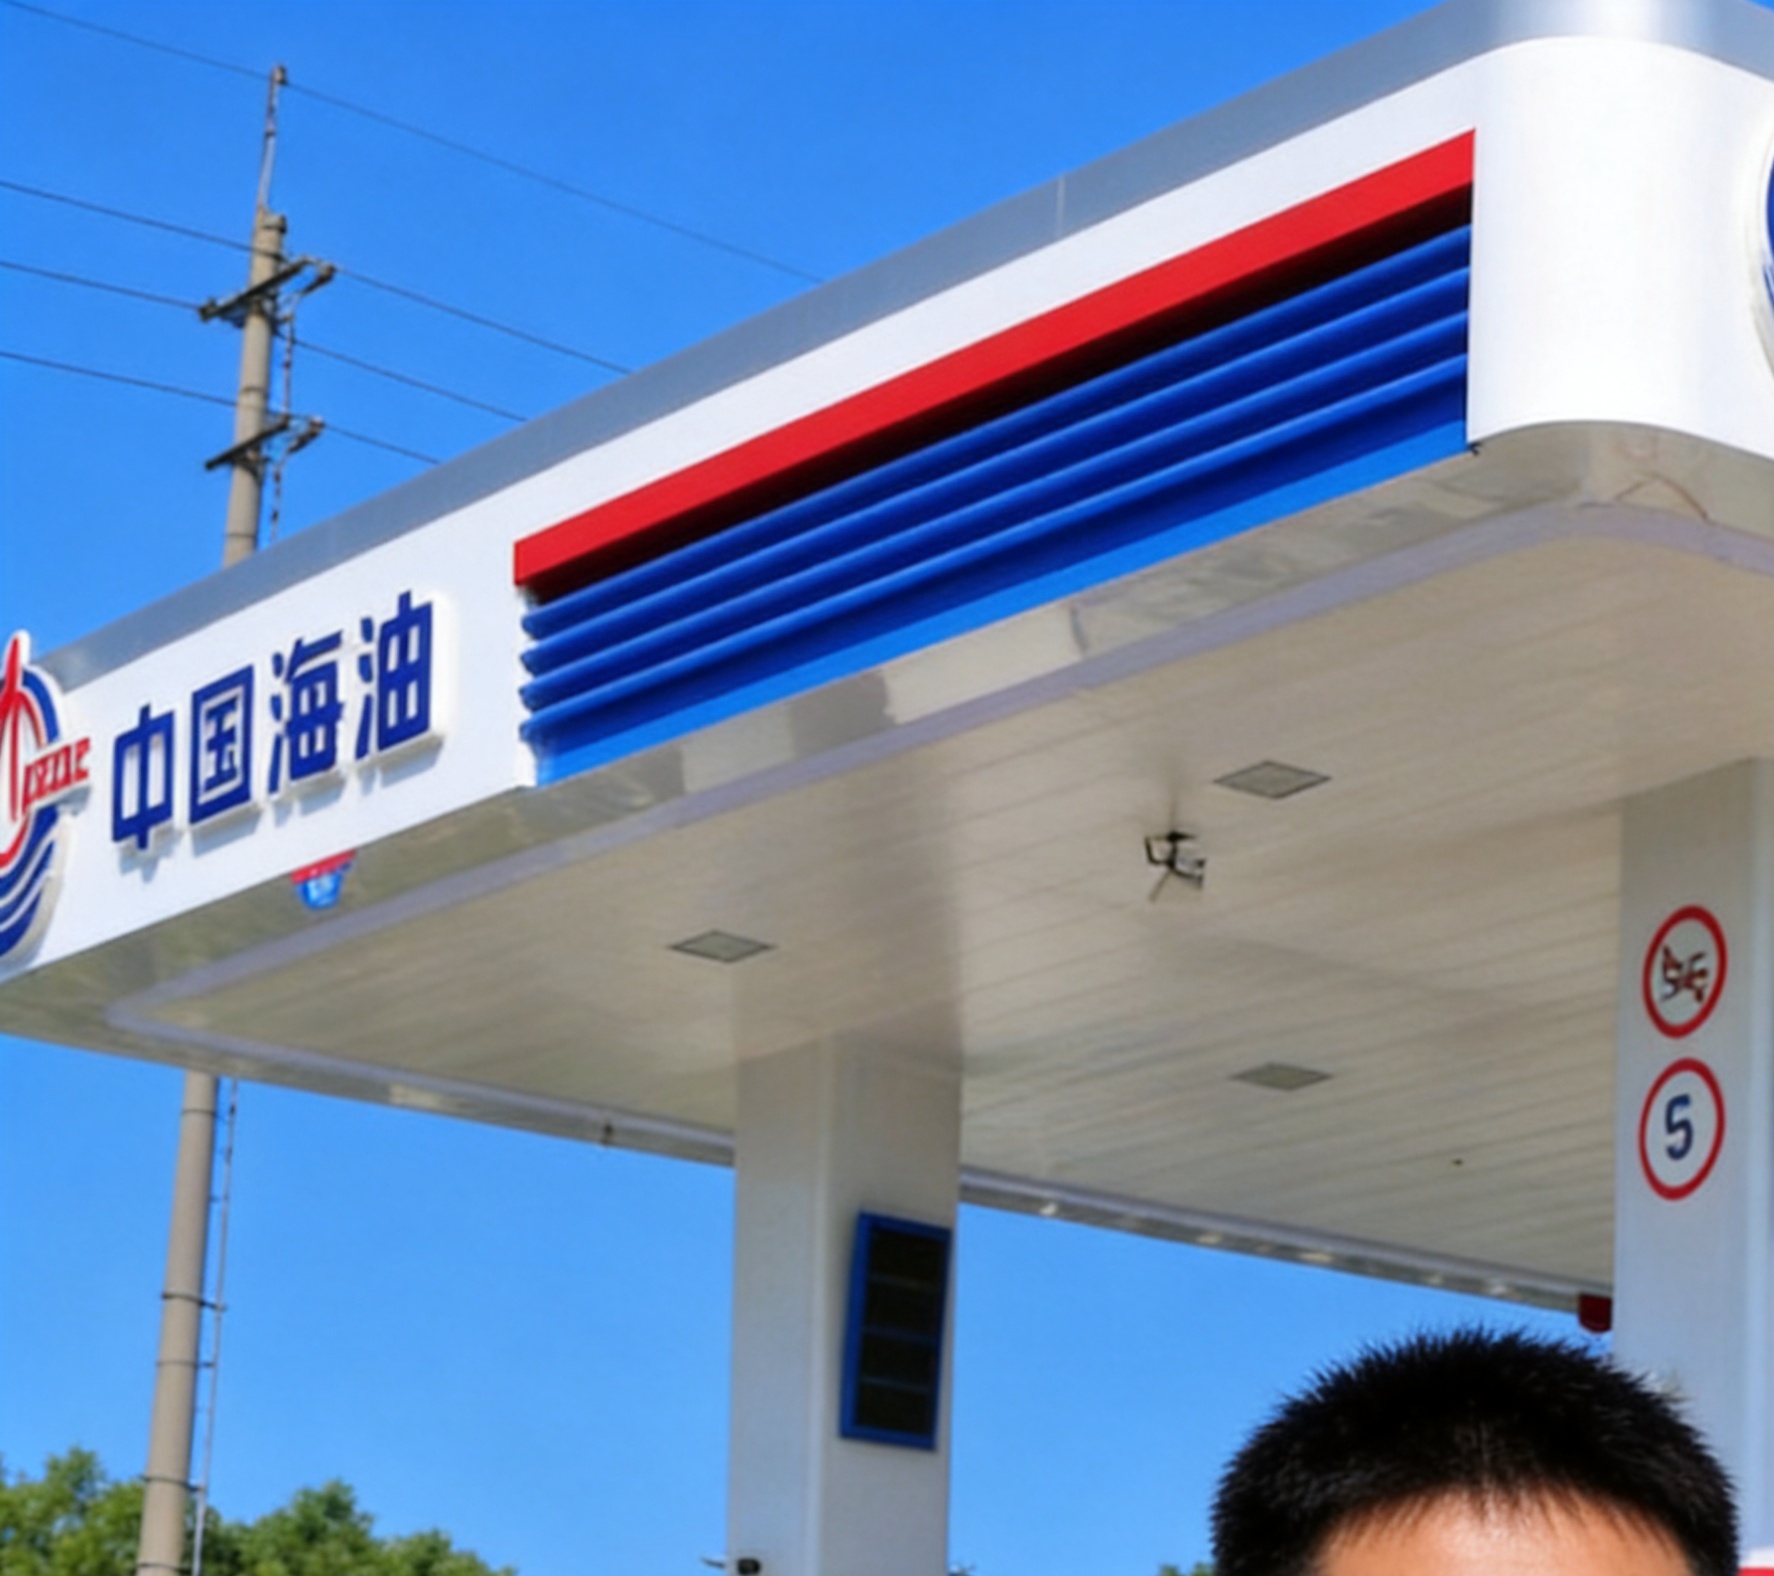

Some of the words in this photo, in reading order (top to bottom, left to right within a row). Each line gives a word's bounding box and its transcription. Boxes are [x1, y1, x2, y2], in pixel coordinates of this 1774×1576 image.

[111, 589, 434, 850] 中国海油
[1664, 1093, 1694, 1162] 5
